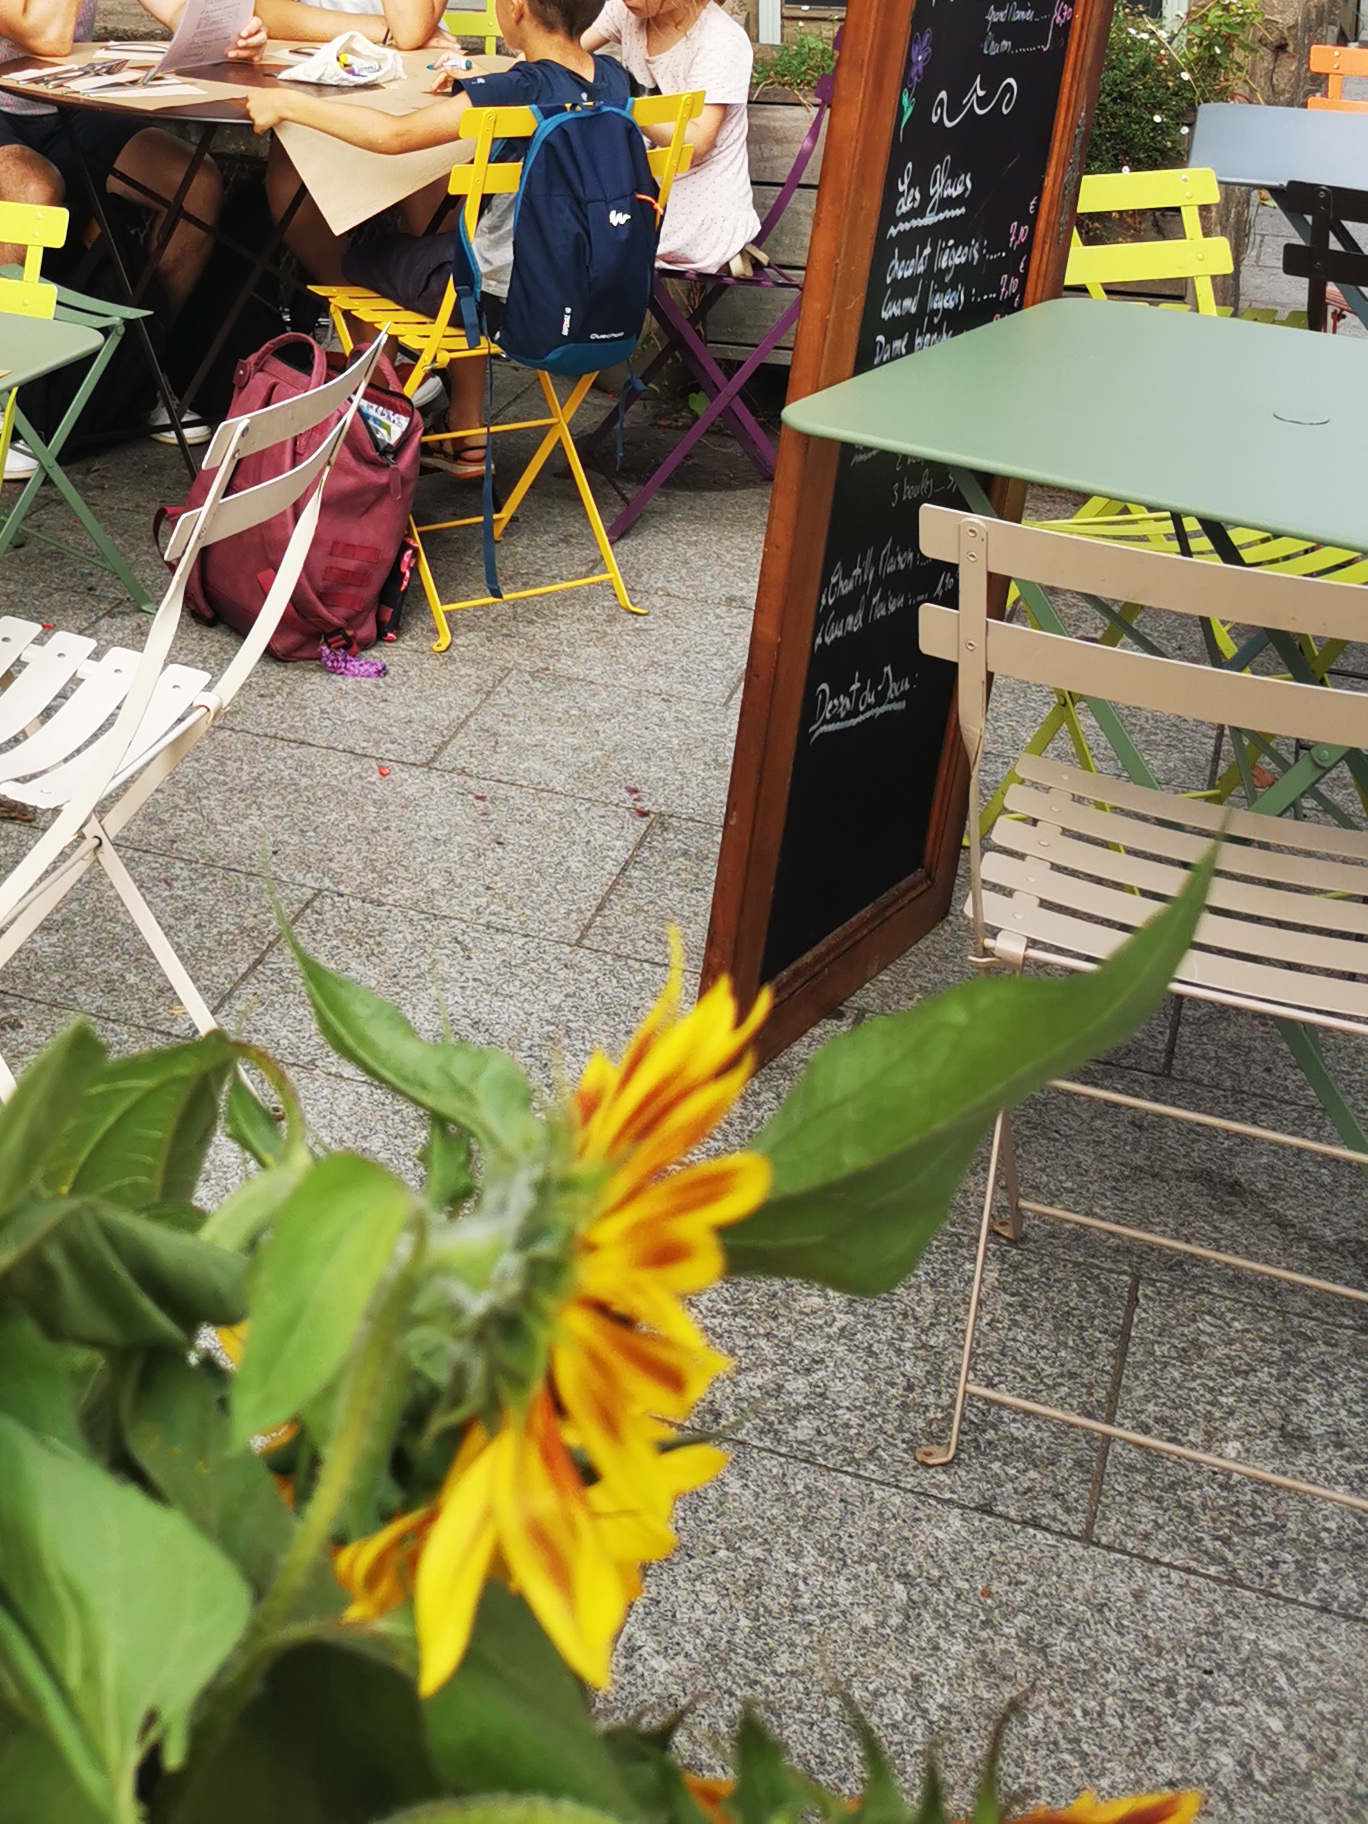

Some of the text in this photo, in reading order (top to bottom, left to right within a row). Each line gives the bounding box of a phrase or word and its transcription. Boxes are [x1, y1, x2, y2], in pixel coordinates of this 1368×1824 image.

[895, 154, 972, 217] Les Glaces
[873, 330, 910, 365] Dame
[809, 670, 862, 735] Dessert
[859, 678, 876, 712] du
